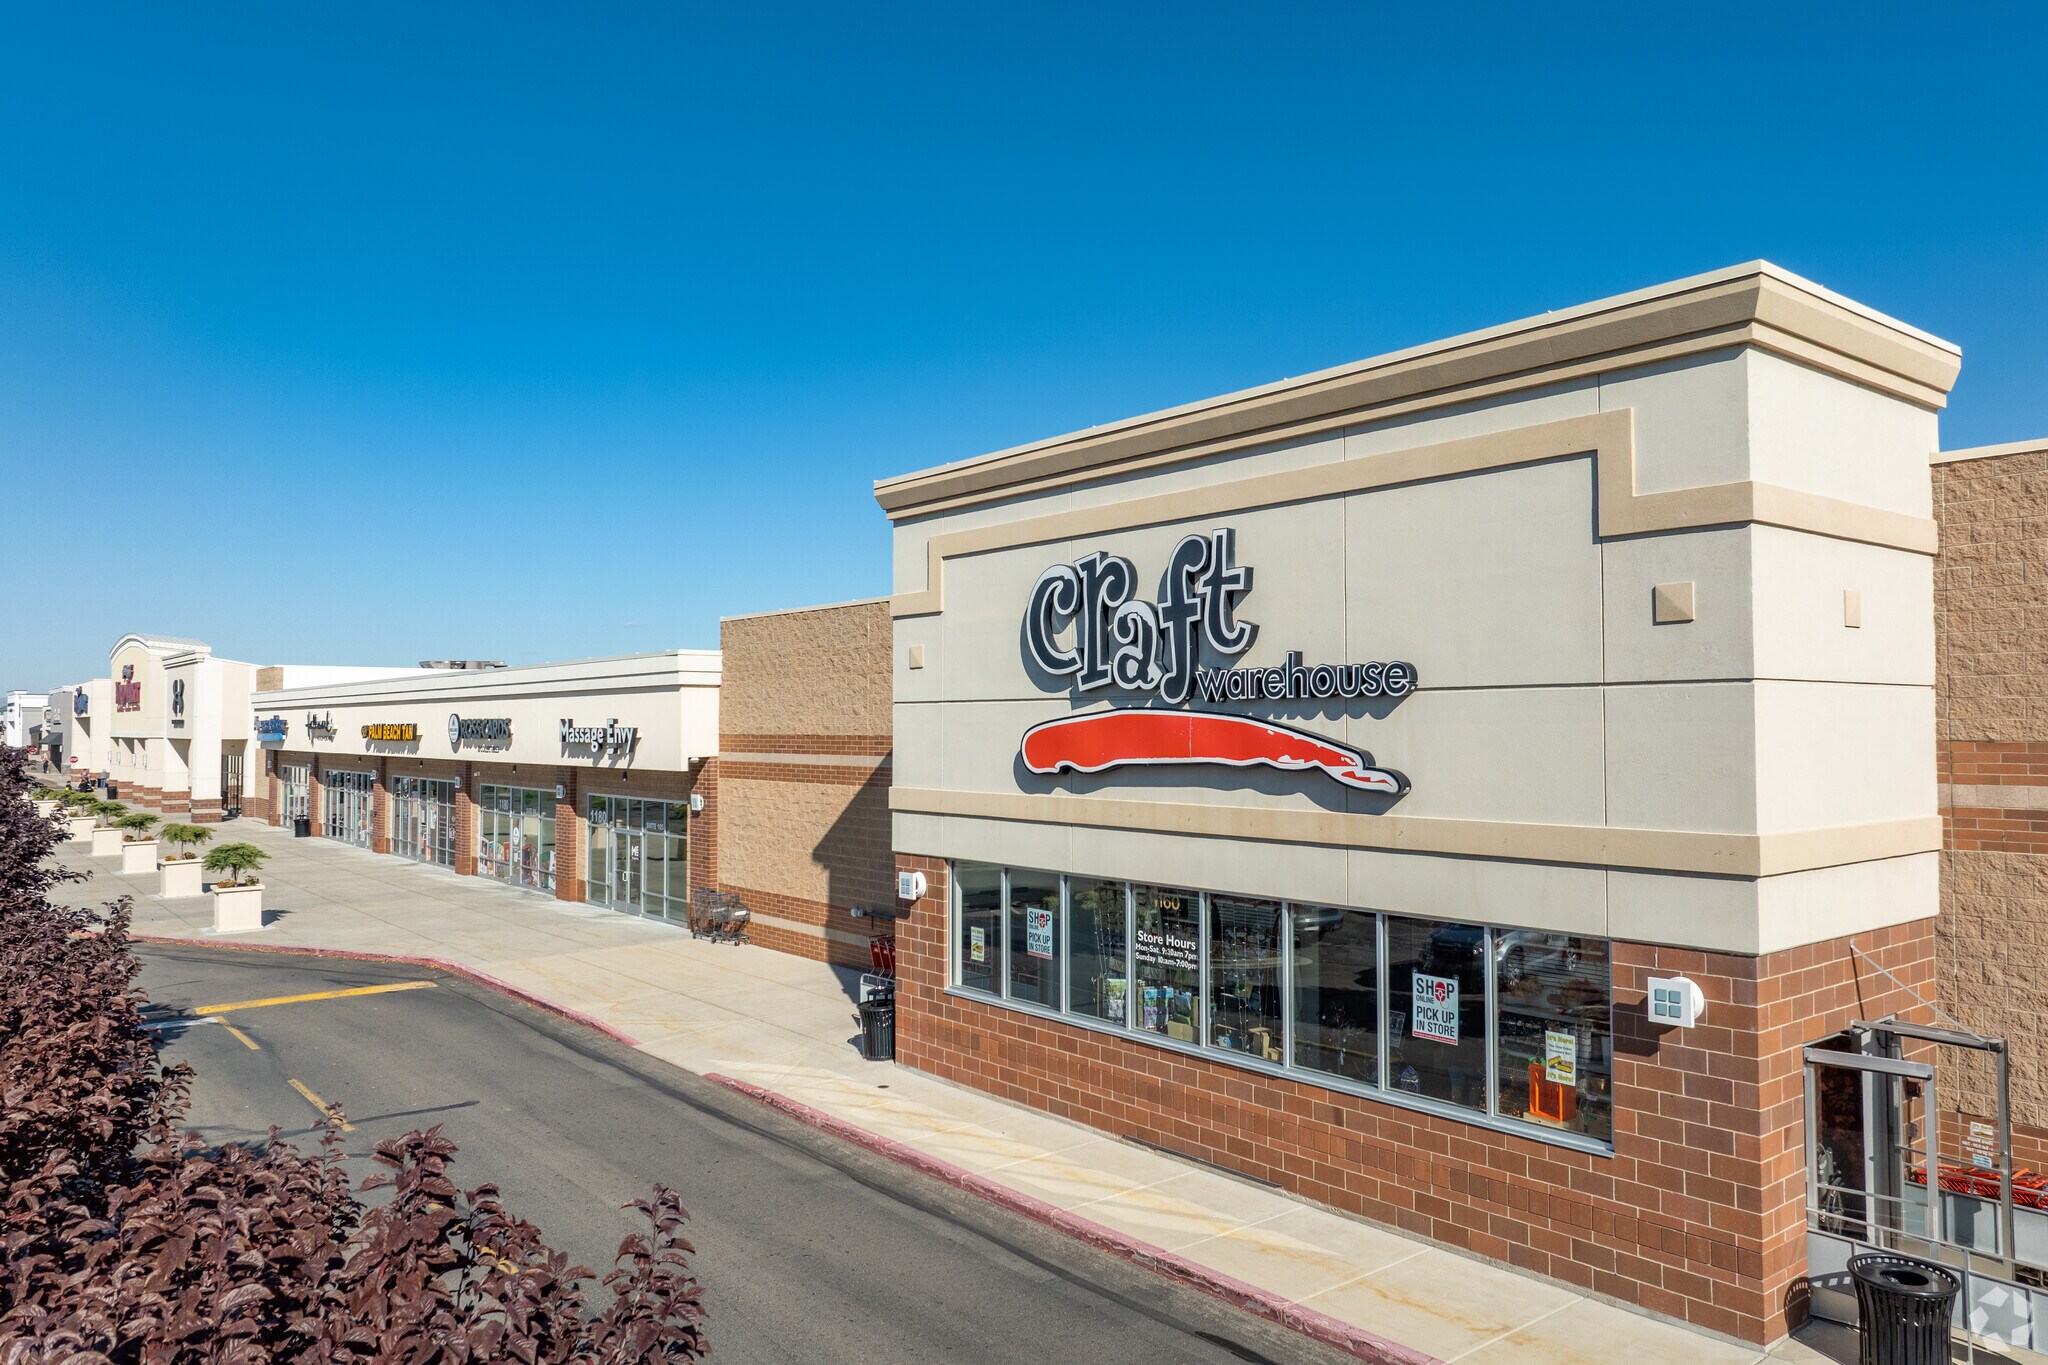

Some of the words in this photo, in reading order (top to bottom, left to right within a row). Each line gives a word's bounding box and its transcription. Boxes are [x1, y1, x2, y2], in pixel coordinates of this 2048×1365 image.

[1196, 650, 1418, 703] warehouse
[368, 723, 382, 739] PALM
[383, 723, 401, 740] BEACH
[402, 723, 416, 740] TAN
[559, 718, 605, 752] Massage
[606, 718, 638, 754] Envy
[590, 809, 607, 823] 1180
[1028, 910, 1051, 929] SHOP
[1028, 931, 1042, 944] PICK
[1042, 935, 1051, 945] UP
[1137, 930, 1164, 946] Store
[1165, 934, 1196, 951] Hours
[1028, 943, 1034, 951] IN
[1035, 944, 1051, 955] STORE
[1135, 952, 1157, 964] Sunday
[1416, 977, 1455, 1002] SHOP
[1416, 994, 1435, 1005] ONLINE
[1416, 1005, 1440, 1022] PICK
[1441, 1010, 1455, 1025] UP
[1416, 1018, 1425, 1031] IN
[1427, 1021, 1455, 1038] STORE
